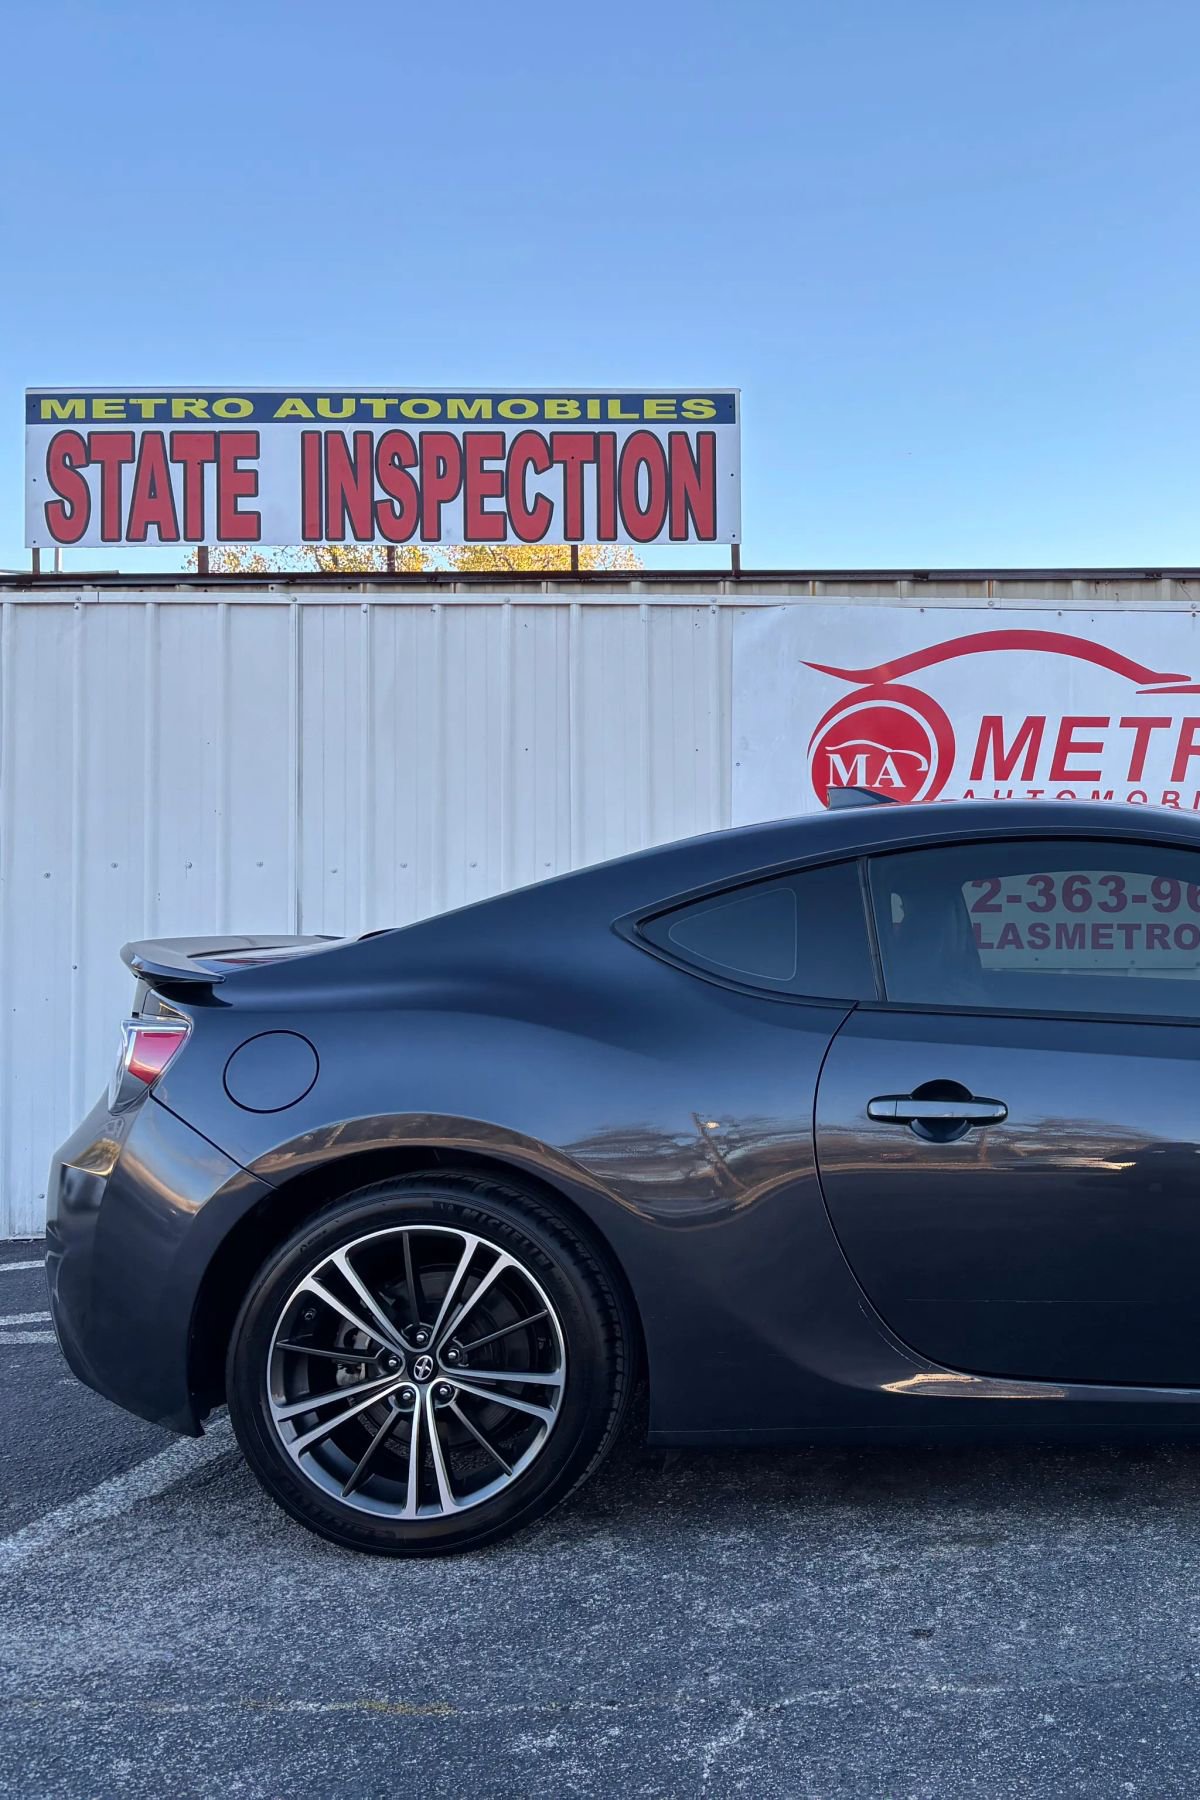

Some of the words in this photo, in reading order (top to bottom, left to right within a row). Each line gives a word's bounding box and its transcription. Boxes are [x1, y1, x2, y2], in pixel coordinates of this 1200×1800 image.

[39, 397, 255, 419] METRO
[273, 397, 718, 420] AUTOMOBILES
[45, 430, 262, 543] STATE
[301, 429, 717, 543] INSPECTION
[825, 753, 907, 788] MA
